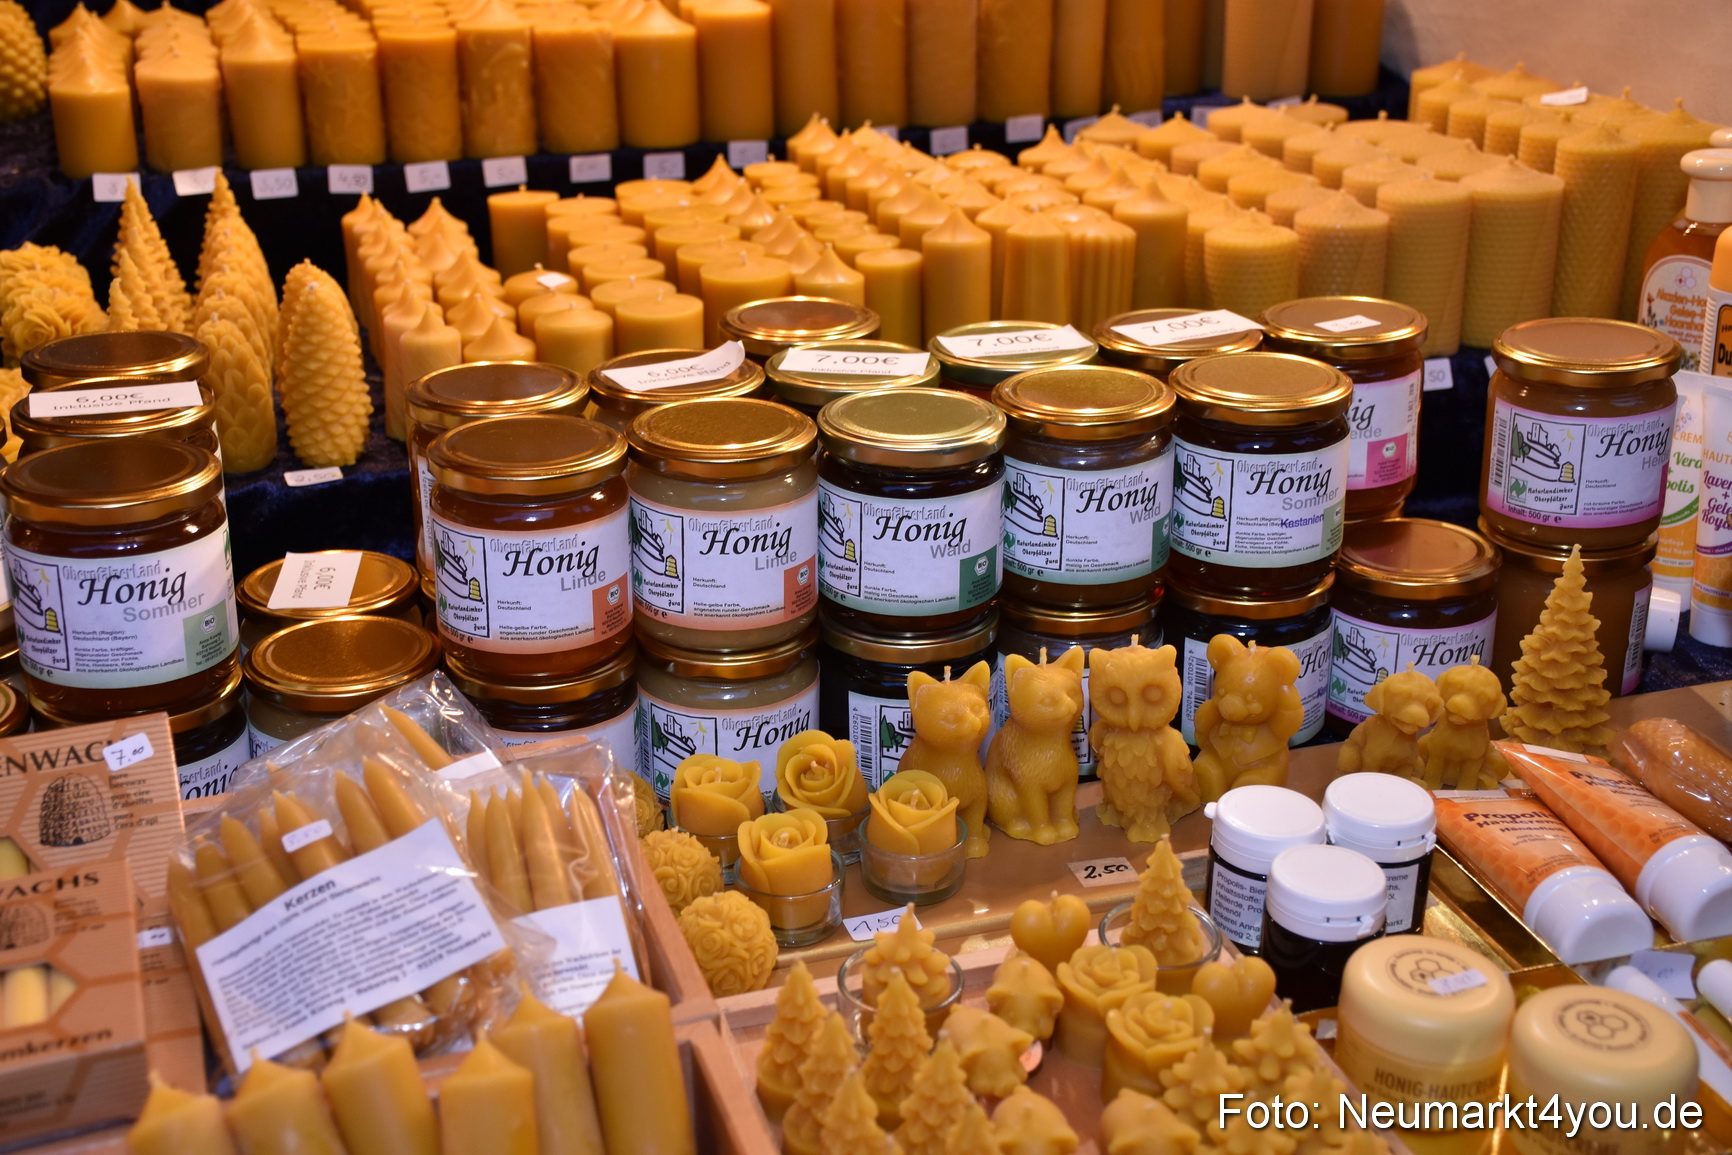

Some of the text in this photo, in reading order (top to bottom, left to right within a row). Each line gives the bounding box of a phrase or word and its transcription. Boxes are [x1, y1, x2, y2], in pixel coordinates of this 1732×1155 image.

[1142, 315, 1222, 336] 7,00€
[968, 332, 1053, 348] 7,00€
[815, 354, 900, 366] 7,00€
[647, 364, 704, 378] 6,00€
[53, 397, 171, 410] Inklusive Pfand
[77, 393, 144, 403] 6,00€
[1596, 423, 1670, 458] Honig
[1673, 432, 1702, 443] CREM
[1246, 464, 1332, 497] Honig
[1704, 470, 1732, 489] Laven
[1076, 478, 1159, 514] Honig
[1282, 488, 1339, 511] Sommer
[1528, 487, 1573, 495] Naturlandimker
[1534, 495, 1568, 503] Oberpfälzer
[1130, 504, 1161, 525] Wald
[1281, 514, 1325, 529] Kastanien
[1508, 505, 1551, 522] Inhalt: 500 gr
[1702, 509, 1731, 531] Roya
[873, 513, 967, 548] Honig
[1185, 520, 1224, 529] Naturlandimker
[1191, 529, 1220, 538] Oberpfälzer
[700, 522, 792, 558] Honig
[930, 539, 971, 559] Wald
[1017, 539, 1057, 548] Naturlandimker
[1185, 542, 1195, 552] 500
[503, 541, 600, 578] Honig
[755, 551, 797, 571] Linde
[1022, 548, 1052, 556] Oberpfälzer
[314, 566, 336, 590] 6,00€
[1017, 562, 1034, 575] 500 gr
[78, 568, 187, 606] Honig
[561, 570, 607, 592] Linde
[846, 582, 858, 590] Jura
[123, 592, 205, 622] Sommer
[72, 629, 97, 637] Herkunft
[474, 623, 486, 631] Jura
[111, 634, 138, 642] (Bayern)
[1413, 635, 1486, 666] Honig
[1083, 864, 1129, 880] 2.50
[1217, 871, 1247, 892] Propolis-
[1, 872, 99, 899] ACHS
[1216, 881, 1262, 904] Inhaltsstoffe:
[283, 879, 337, 912] Kerzen
[1215, 890, 1245, 911] Heilerde,
[1214, 899, 1241, 918] Olivenöl
[1213, 908, 1260, 933] Imkerei Anna
[1245, 933, 1253, 943] 2,
